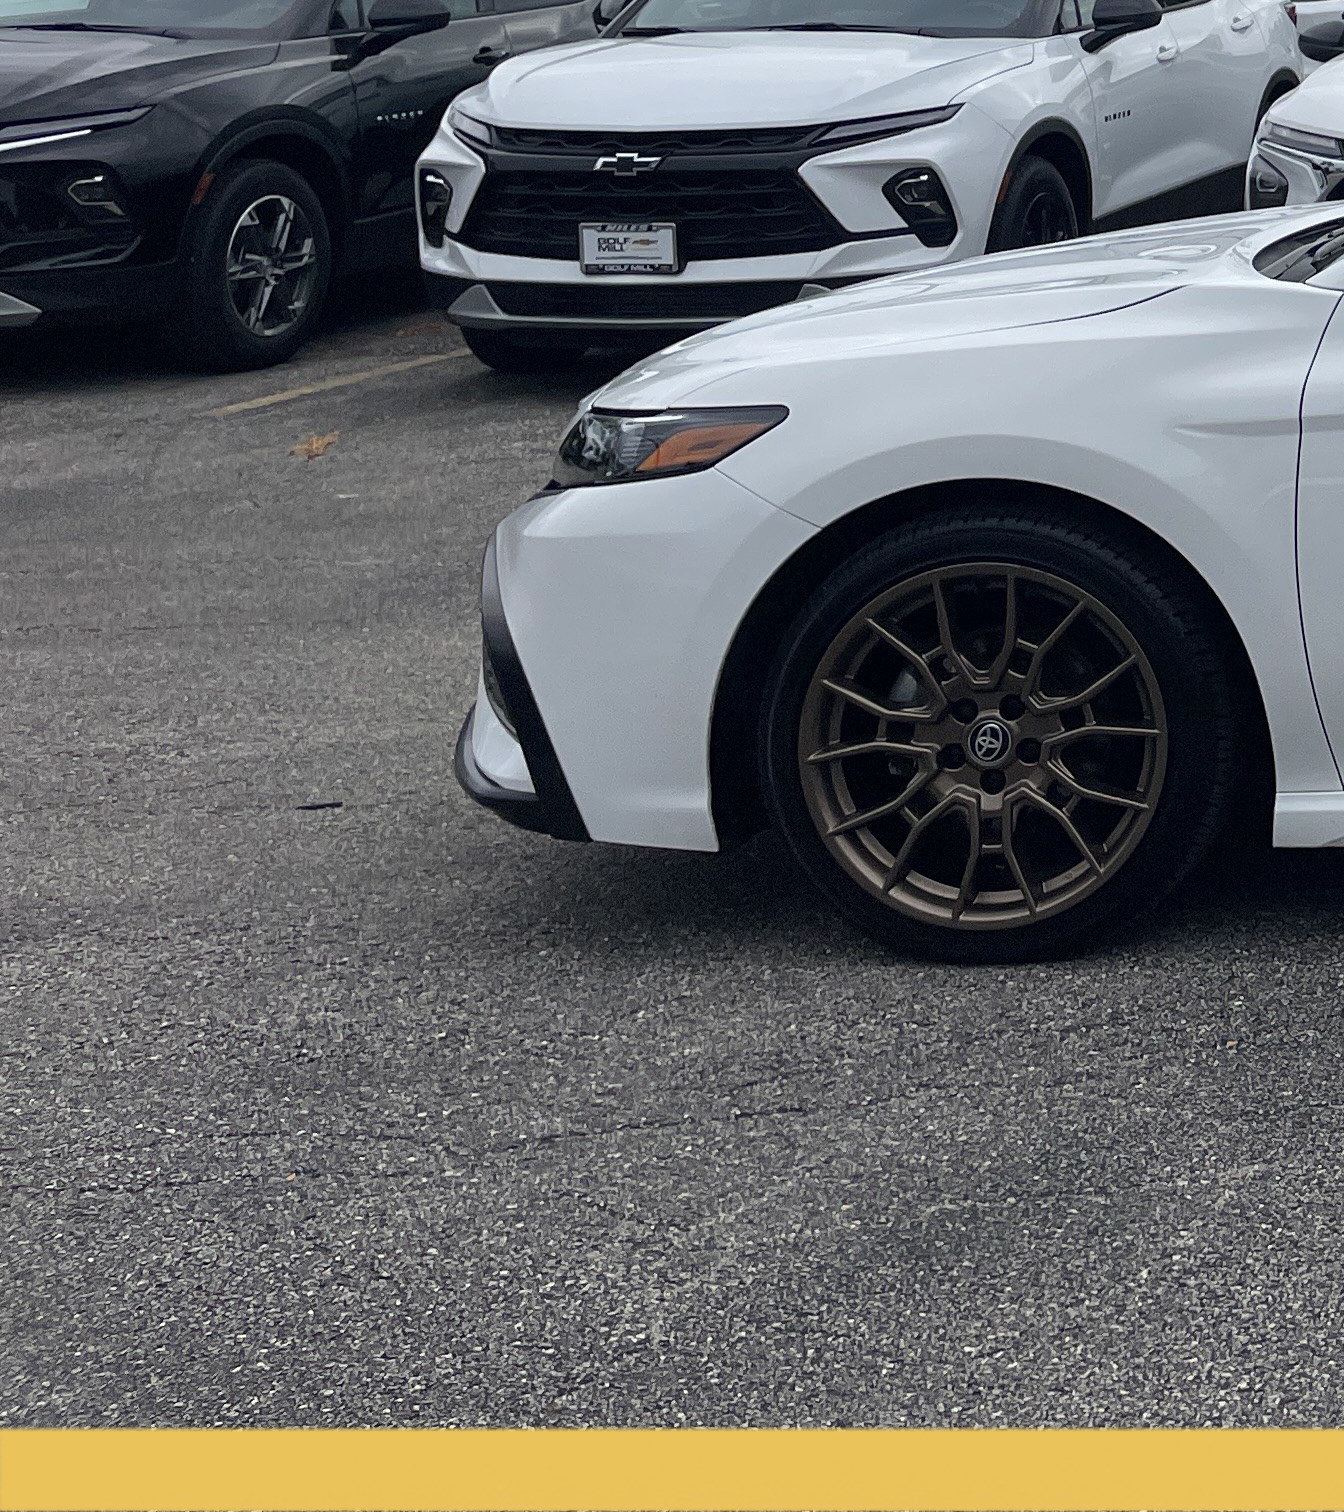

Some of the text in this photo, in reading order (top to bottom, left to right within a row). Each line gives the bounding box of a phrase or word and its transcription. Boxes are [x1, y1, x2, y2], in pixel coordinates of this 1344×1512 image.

[598, 237, 631, 245] GOLF
[598, 244, 625, 252] MILL
[604, 264, 654, 272] GOLF MILL
